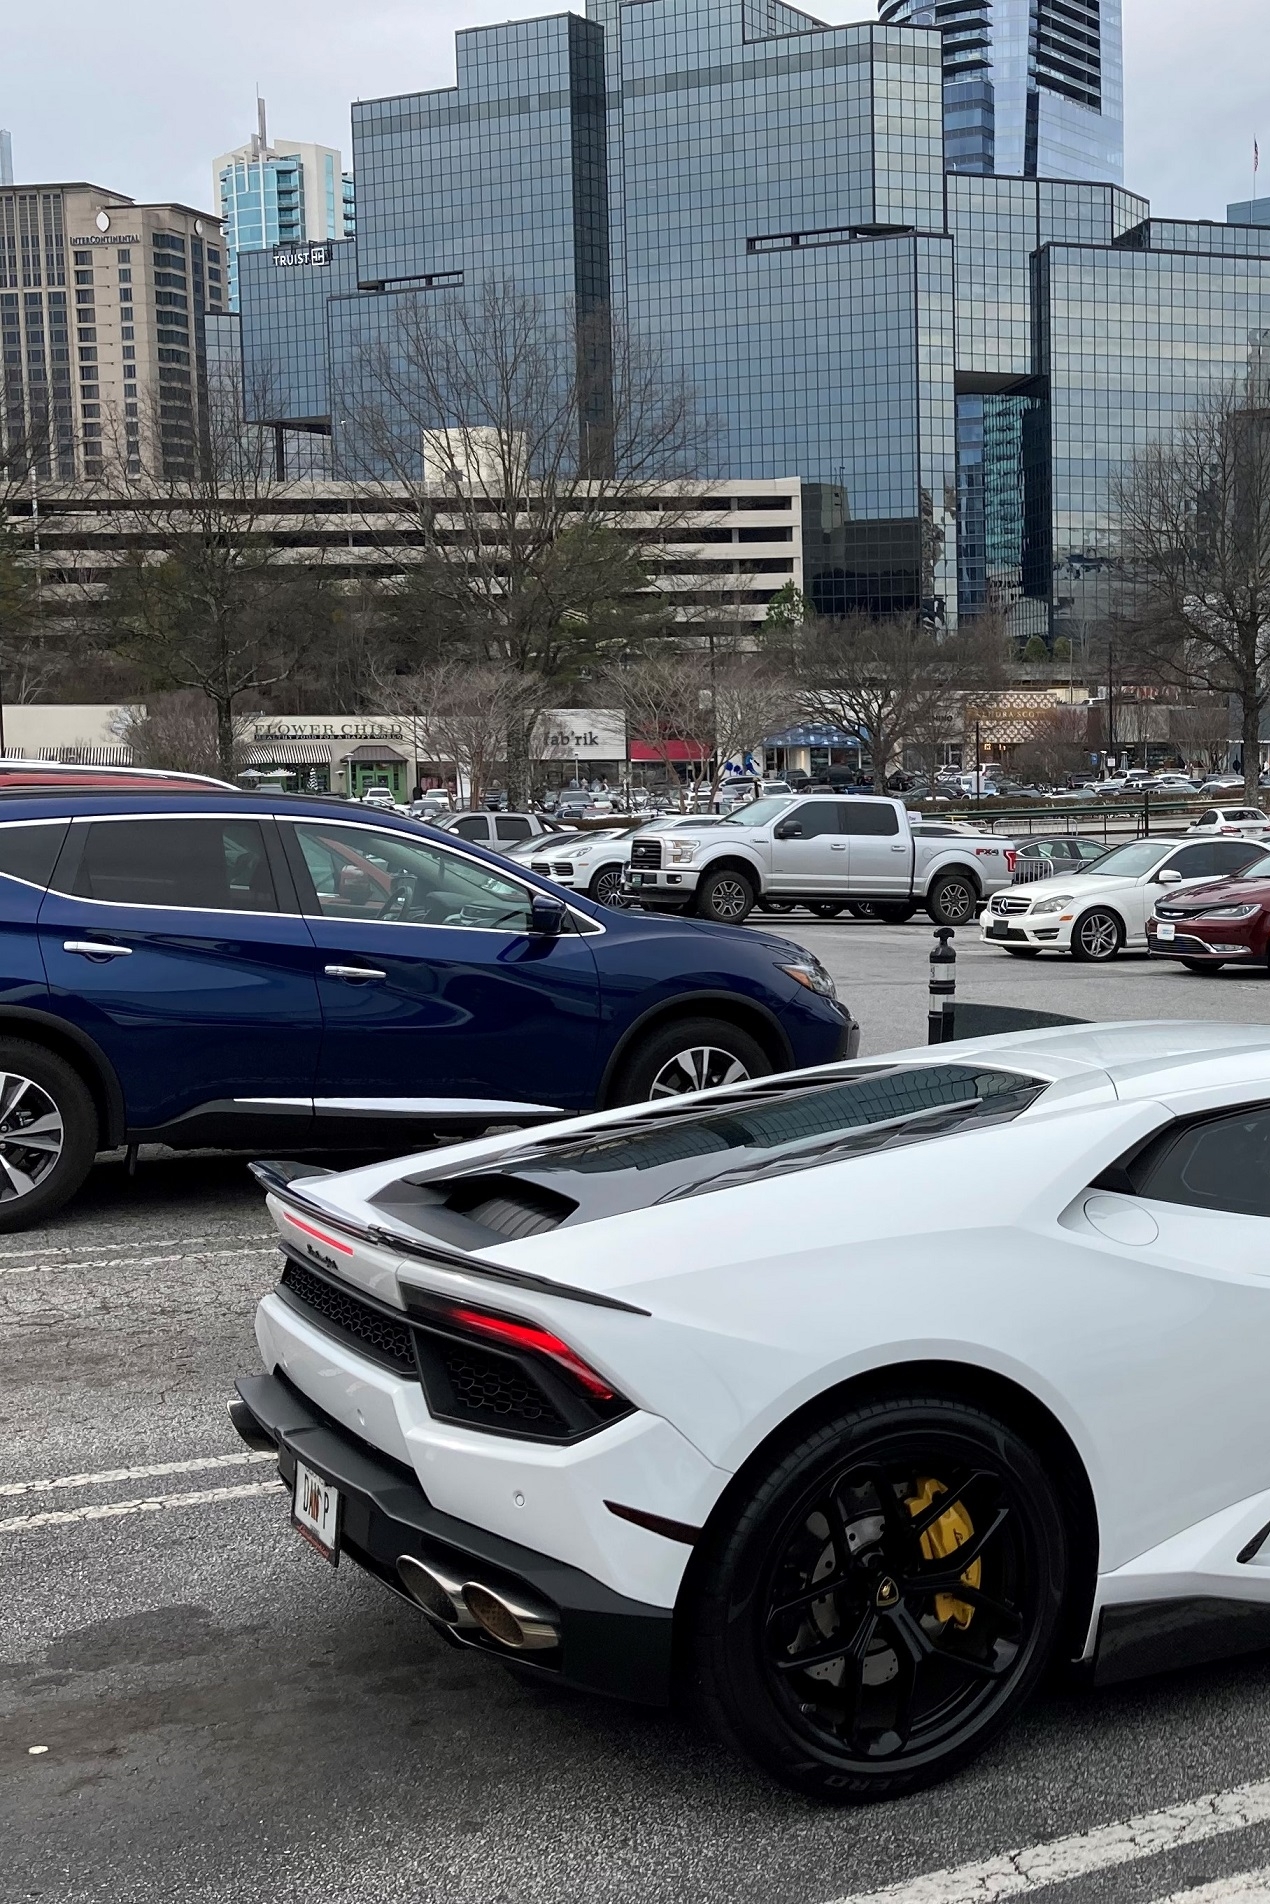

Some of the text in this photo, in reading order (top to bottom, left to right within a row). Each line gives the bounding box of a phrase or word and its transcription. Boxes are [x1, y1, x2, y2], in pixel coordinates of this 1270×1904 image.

[273, 253, 309, 266] TRUIST
[254, 724, 402, 735] FLOWER CHILD
